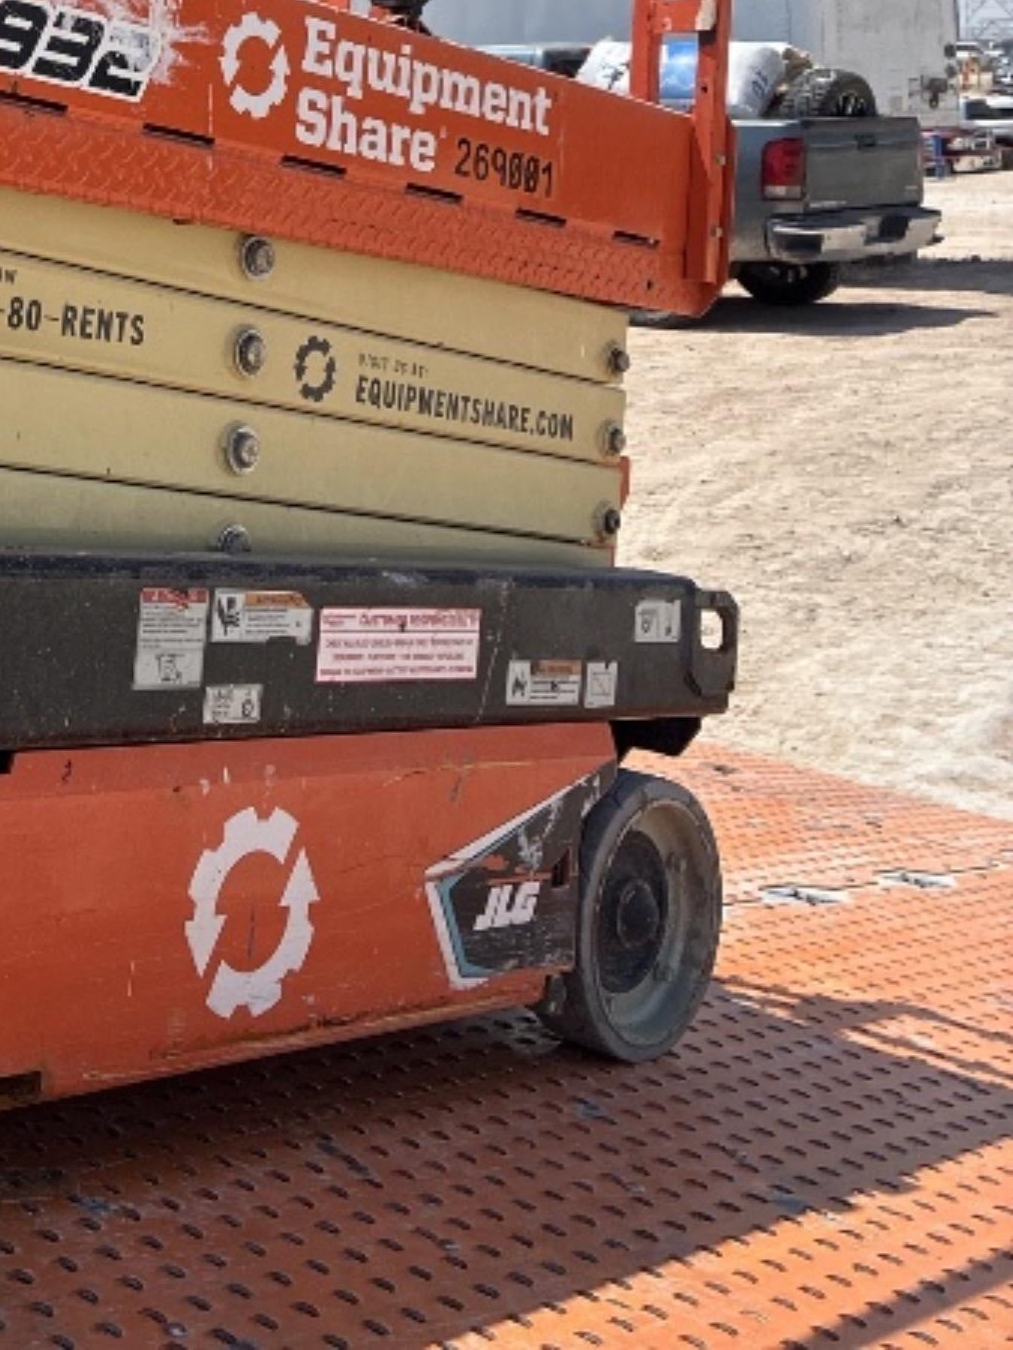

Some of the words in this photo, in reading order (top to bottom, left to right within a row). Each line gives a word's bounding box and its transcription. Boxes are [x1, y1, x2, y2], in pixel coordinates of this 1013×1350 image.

[301, 16, 553, 136] Equipment
[295, 86, 438, 173] Share
[454, 137, 554, 198] 269001
[355, 375, 574, 442] EQUIPMENTSHARE.COM
[472, 881, 540, 931] JLG
